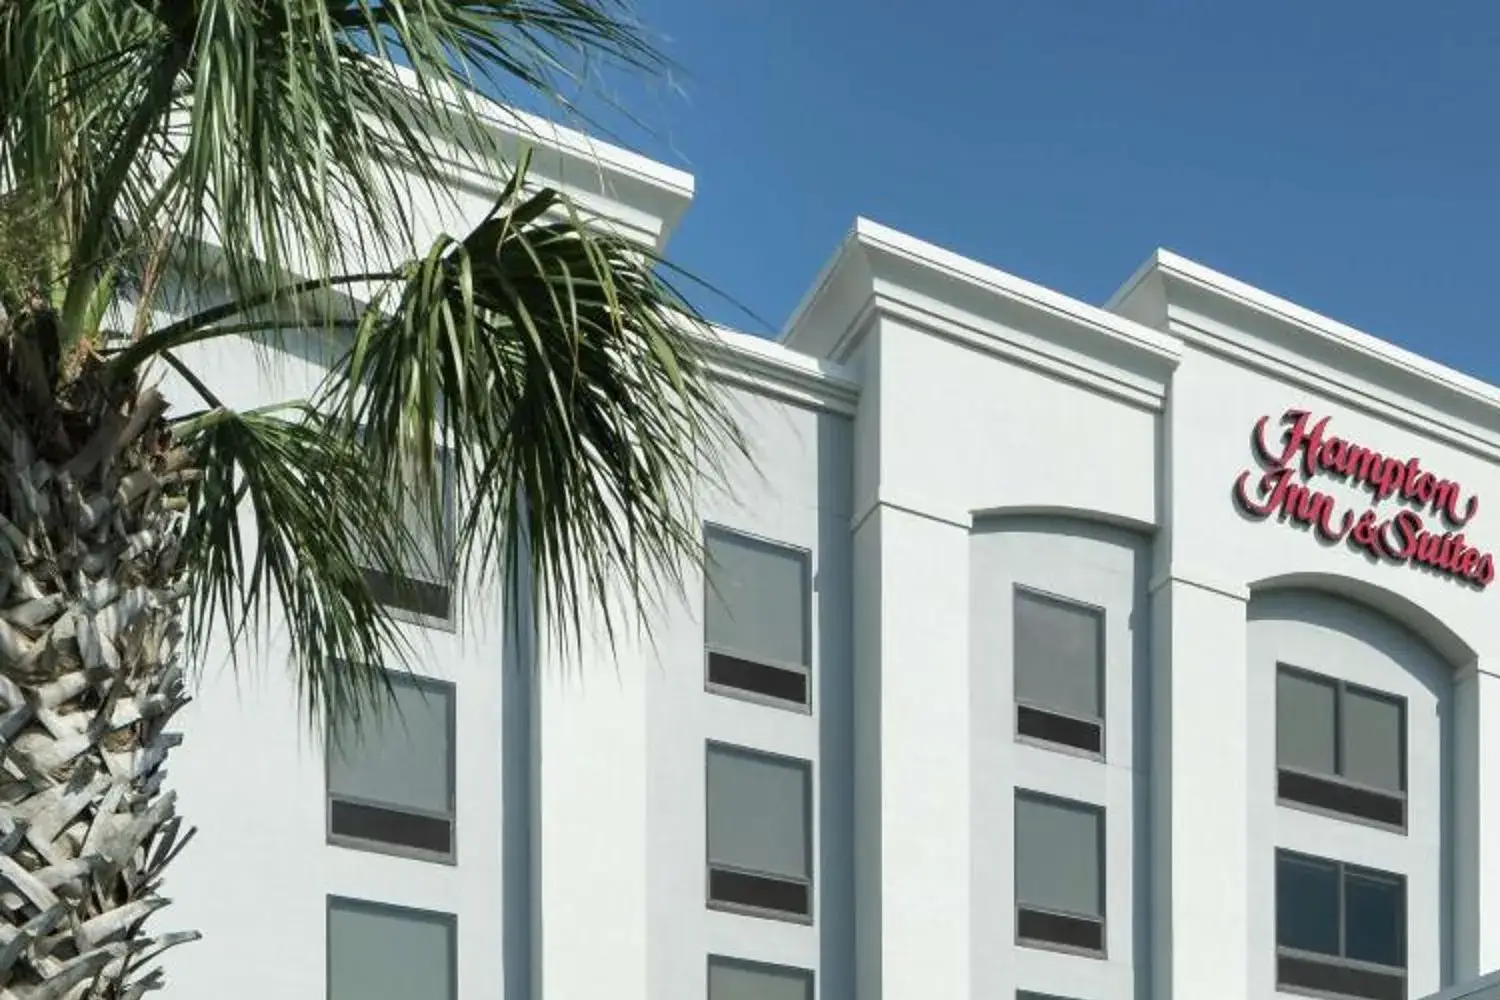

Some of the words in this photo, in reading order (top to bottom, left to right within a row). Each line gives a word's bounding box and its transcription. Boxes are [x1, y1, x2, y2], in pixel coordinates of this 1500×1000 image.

[1232, 468, 1354, 546] Inn
[1349, 509, 1381, 562] &
[1376, 510, 1495, 590] Suites
[1251, 408, 1479, 530] Hampton
